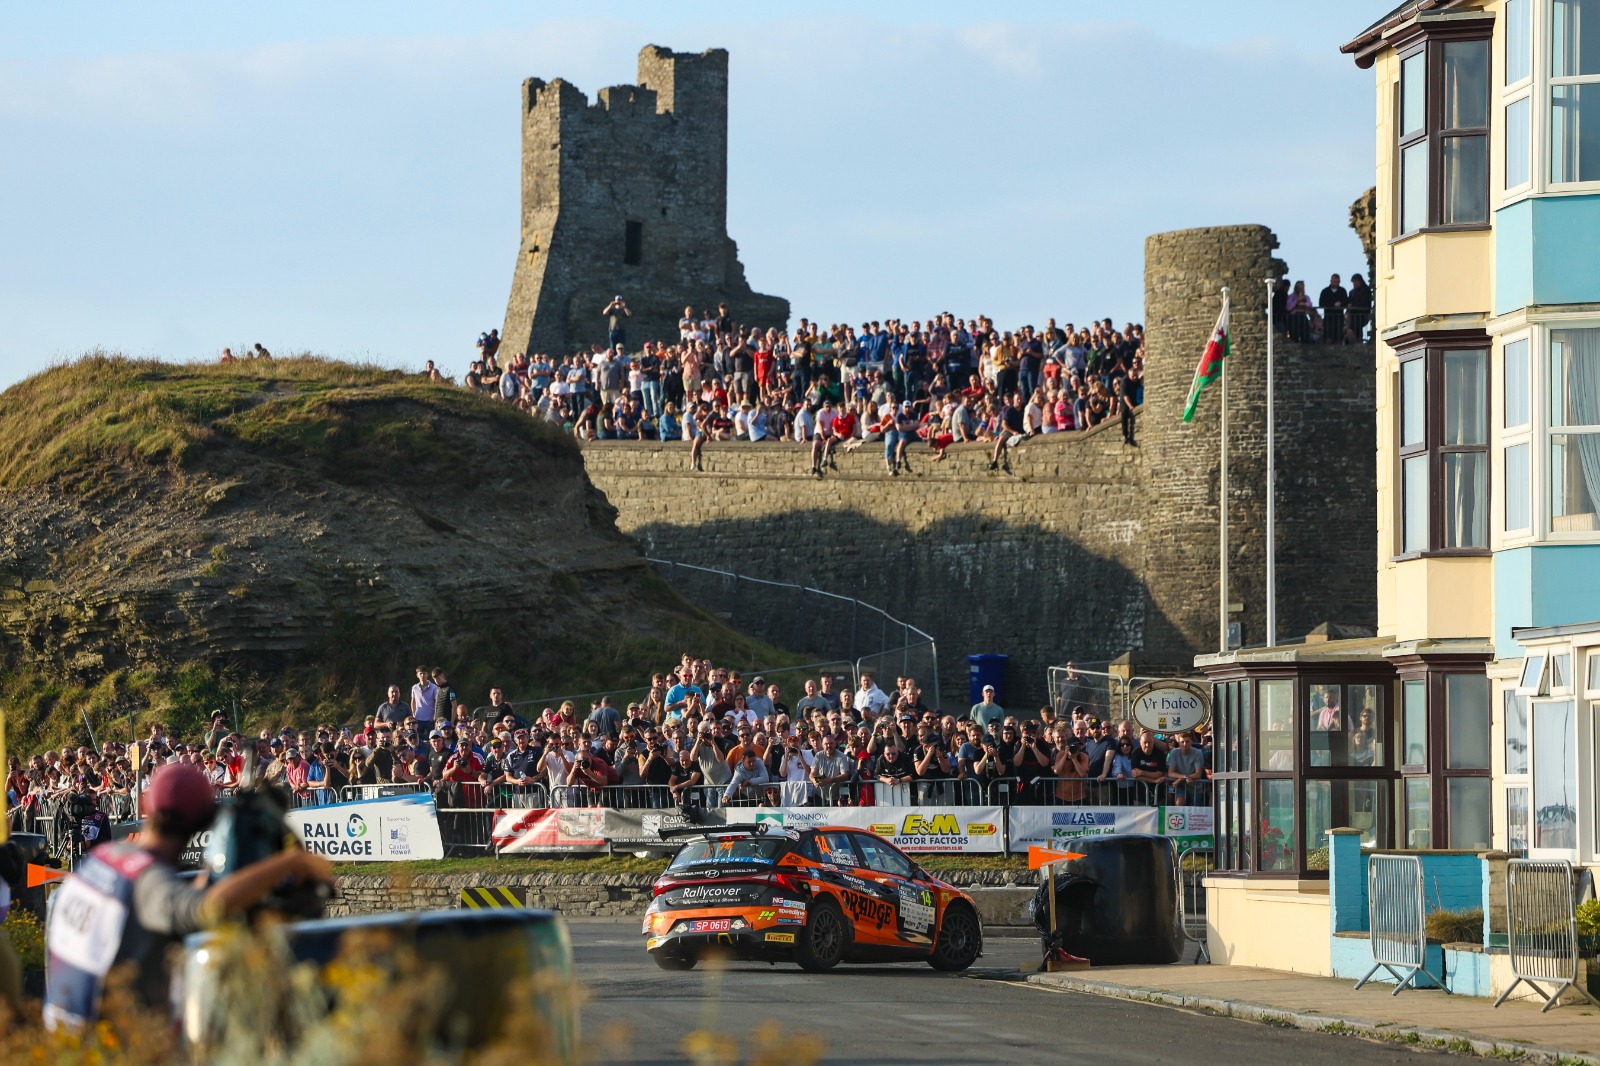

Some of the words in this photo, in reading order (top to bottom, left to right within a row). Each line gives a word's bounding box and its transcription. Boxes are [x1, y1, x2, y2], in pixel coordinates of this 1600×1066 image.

[1142, 698, 1157, 712] Yr
[1162, 697, 1198, 710] Hafod
[786, 812, 830, 820] MONNOW
[1071, 812, 1095, 822] LAS
[303, 822, 339, 838] RALI
[901, 814, 960, 836] E&M
[1052, 826, 1101, 838] Recycling
[305, 840, 372, 855] ENGAGE
[815, 835, 831, 855] 14
[894, 836, 926, 845] MOTOR
[930, 836, 968, 844] FACTORS
[682, 886, 742, 899] Rallycover
[920, 890, 932, 906] 14
[696, 922, 708, 930] SP
[710, 920, 728, 930] 0613
